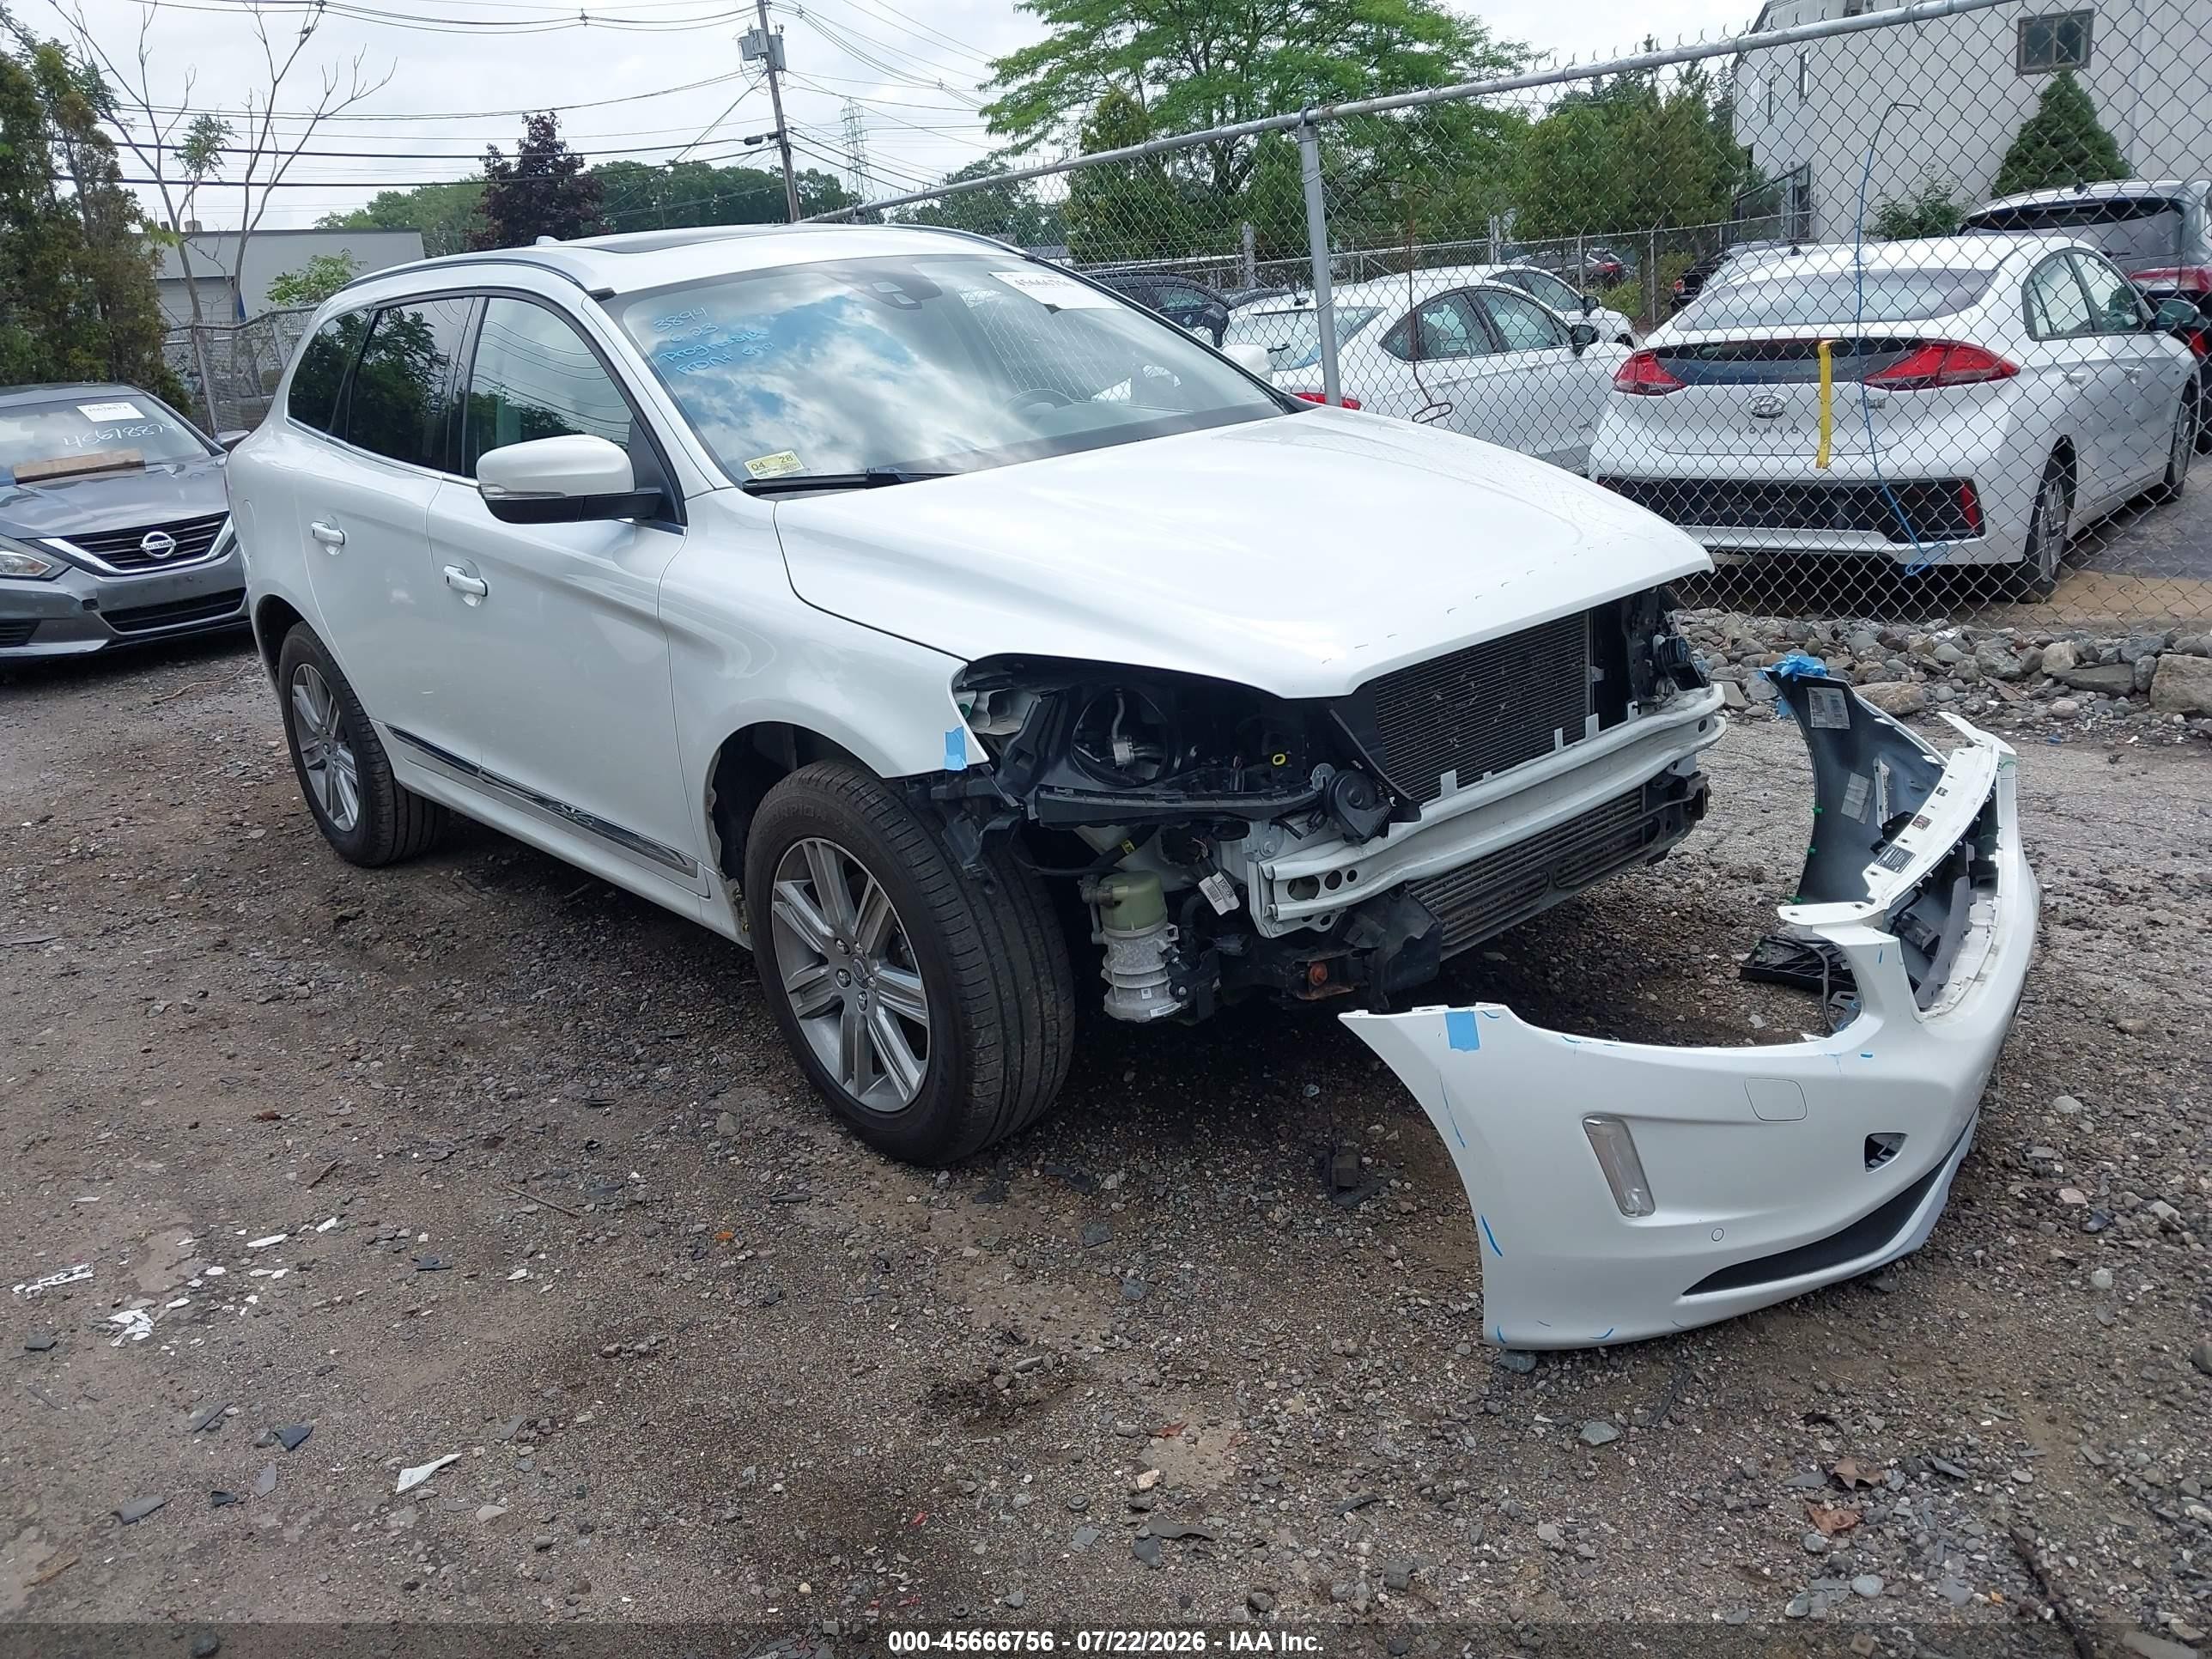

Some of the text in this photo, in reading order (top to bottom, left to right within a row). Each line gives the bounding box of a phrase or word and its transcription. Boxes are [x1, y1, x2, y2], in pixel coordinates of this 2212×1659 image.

[63, 422, 178, 447] 45678874
[751, 462, 765, 471] 04
[779, 454, 793, 464] 28
[144, 540, 174, 550] NISSAN
